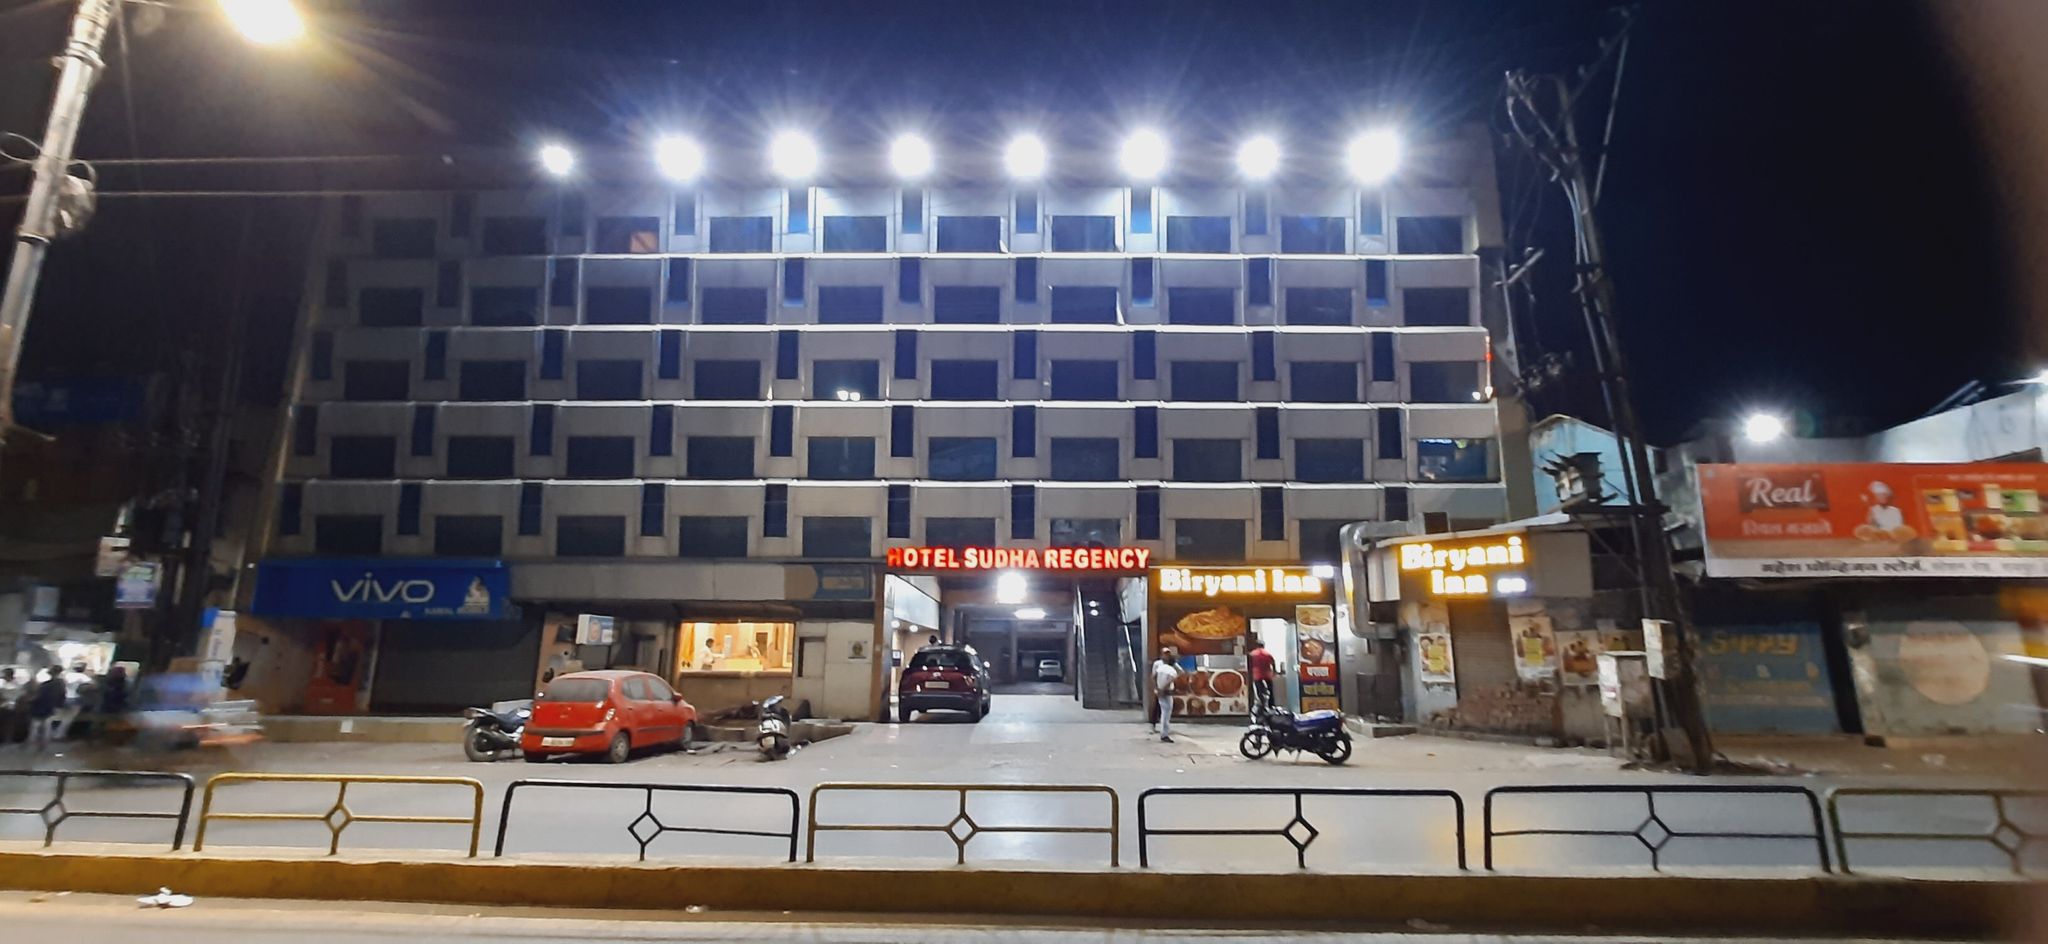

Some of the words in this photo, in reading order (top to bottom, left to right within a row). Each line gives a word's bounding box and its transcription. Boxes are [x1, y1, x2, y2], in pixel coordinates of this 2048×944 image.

[1746, 477, 1816, 507] Real
[887, 547, 960, 569] HOTEL
[963, 547, 1040, 569] SUDHA
[1044, 547, 1150, 569] REGENCY
[1400, 535, 1524, 571] Biryani
[330, 571, 435, 603] vivo
[1159, 568, 1267, 597] Biryani
[1271, 568, 1322, 593] Inn
[1430, 569, 1488, 594] Inn
